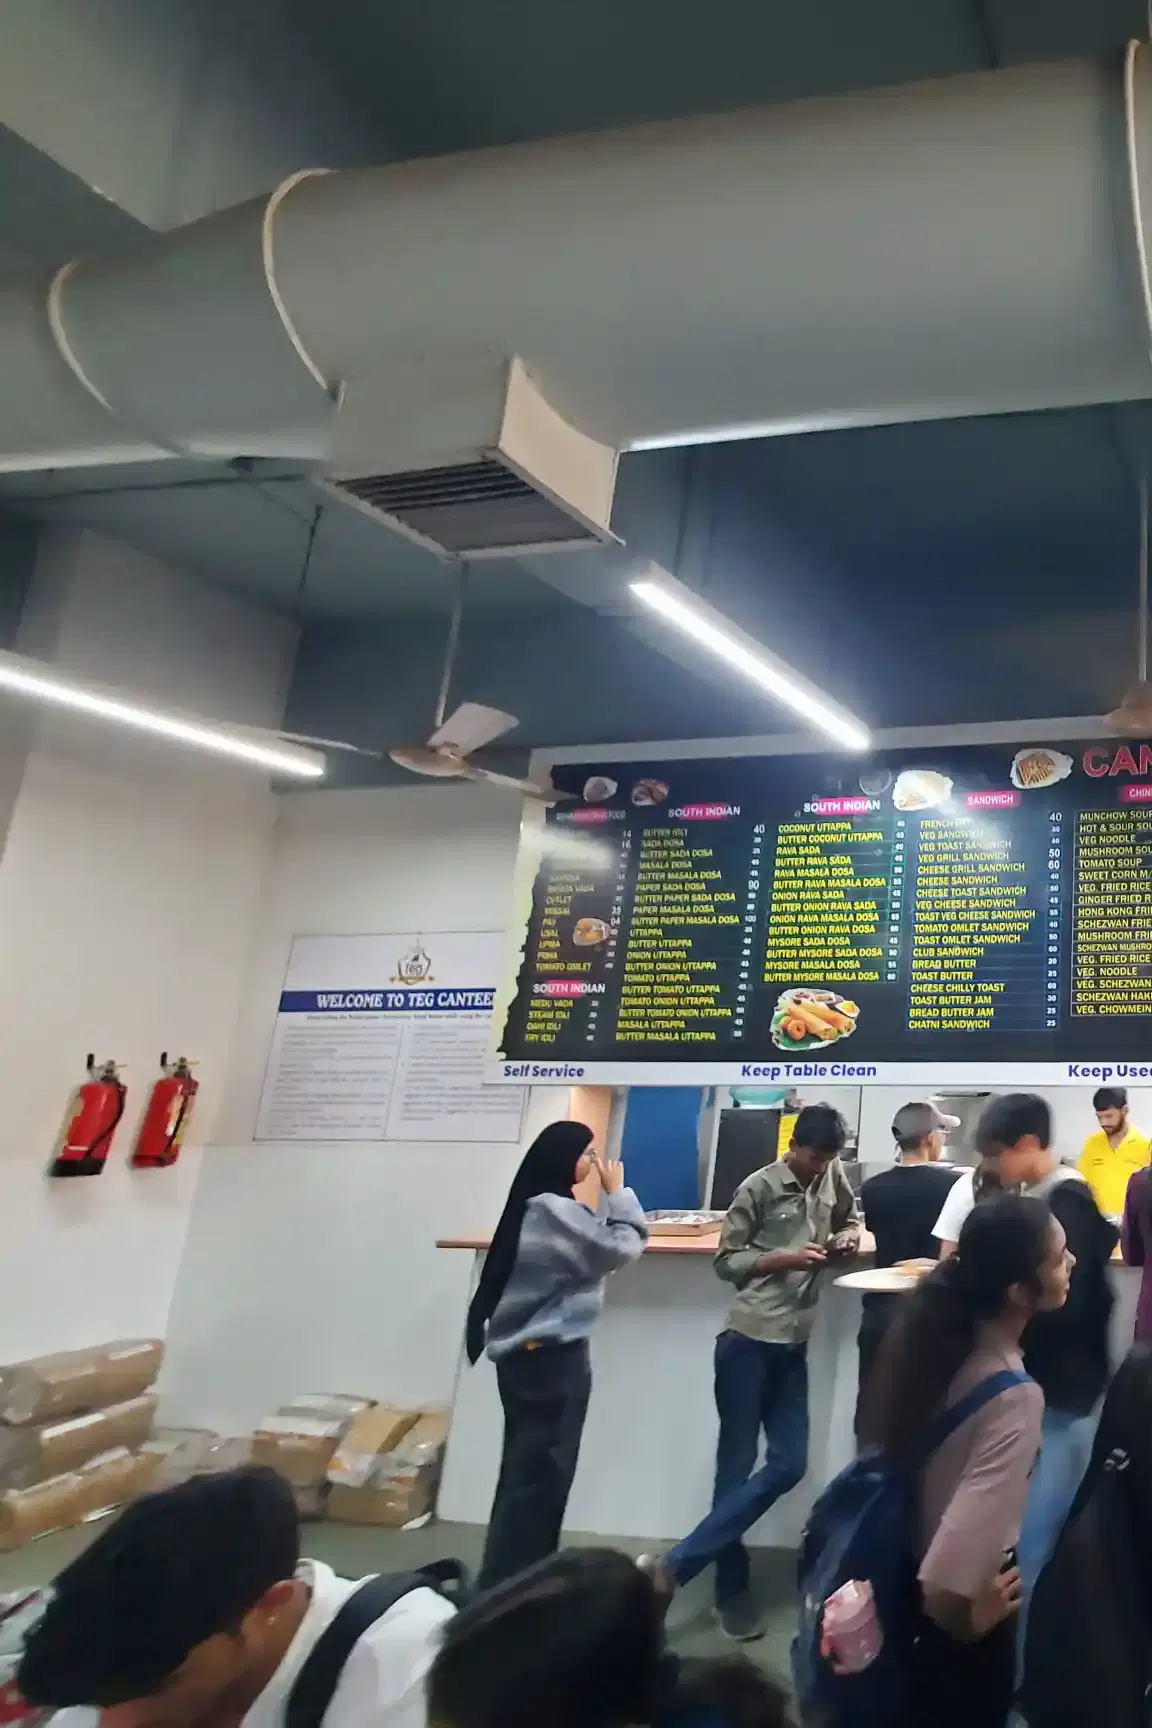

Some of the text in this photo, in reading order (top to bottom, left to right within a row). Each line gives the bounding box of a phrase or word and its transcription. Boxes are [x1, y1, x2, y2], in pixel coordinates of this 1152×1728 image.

[968, 794, 1013, 805] SANDWICH
[804, 800, 880, 812] SOUTH INDIAN
[668, 806, 740, 818] SOUTH INDIAN
[1079, 834, 1136, 844] VEG NOODLE
[1079, 858, 1142, 868] TOMATO SOUP
[917, 875, 998, 886] CHEESE SANDWICH
[1078, 882, 1151, 892] VEG. FRIED RICE
[1078, 907, 1104, 916] HONG
[1106, 906, 1132, 915] KONG
[912, 947, 984, 956] CLUB SANDWICH
[912, 960, 976, 969] BREAD BUTTER
[533, 983, 606, 993] SOUTH INDIAN
[316, 992, 496, 1008] WELCOME TO TEG CANTEE
[1076, 1004, 1152, 1014] VEG. CHOWMEIN
[941, 1020, 990, 1029] SANDWICH
[504, 1064, 585, 1078] Self Service
[742, 1064, 876, 1080] Keep Table Clean
[1068, 1064, 1113, 1081] Keep
